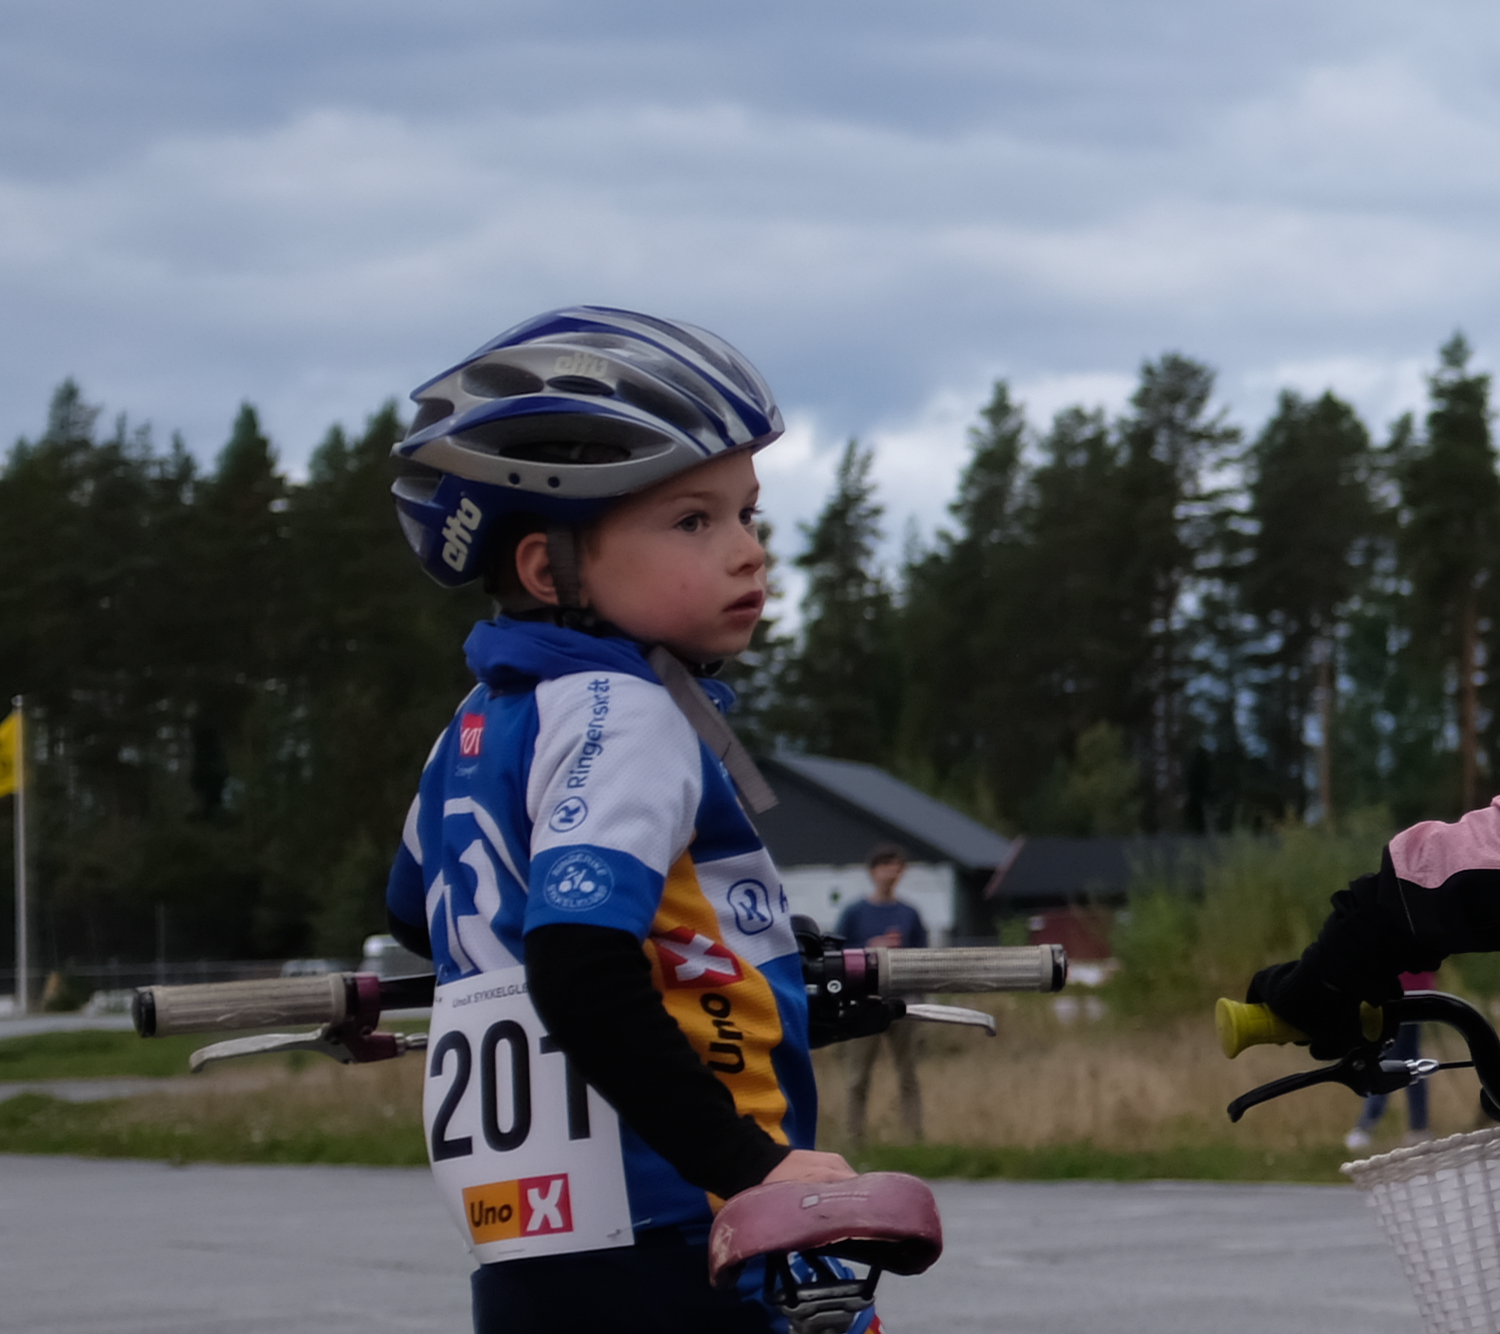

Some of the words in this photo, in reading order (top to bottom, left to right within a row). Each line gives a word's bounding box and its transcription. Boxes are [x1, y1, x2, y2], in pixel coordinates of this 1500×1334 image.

[441, 497, 483, 573] etto
[698, 993, 745, 1074] Uno
[430, 1020, 591, 1163] 201
[471, 1202, 513, 1228] Uno
[526, 1179, 564, 1232] X
